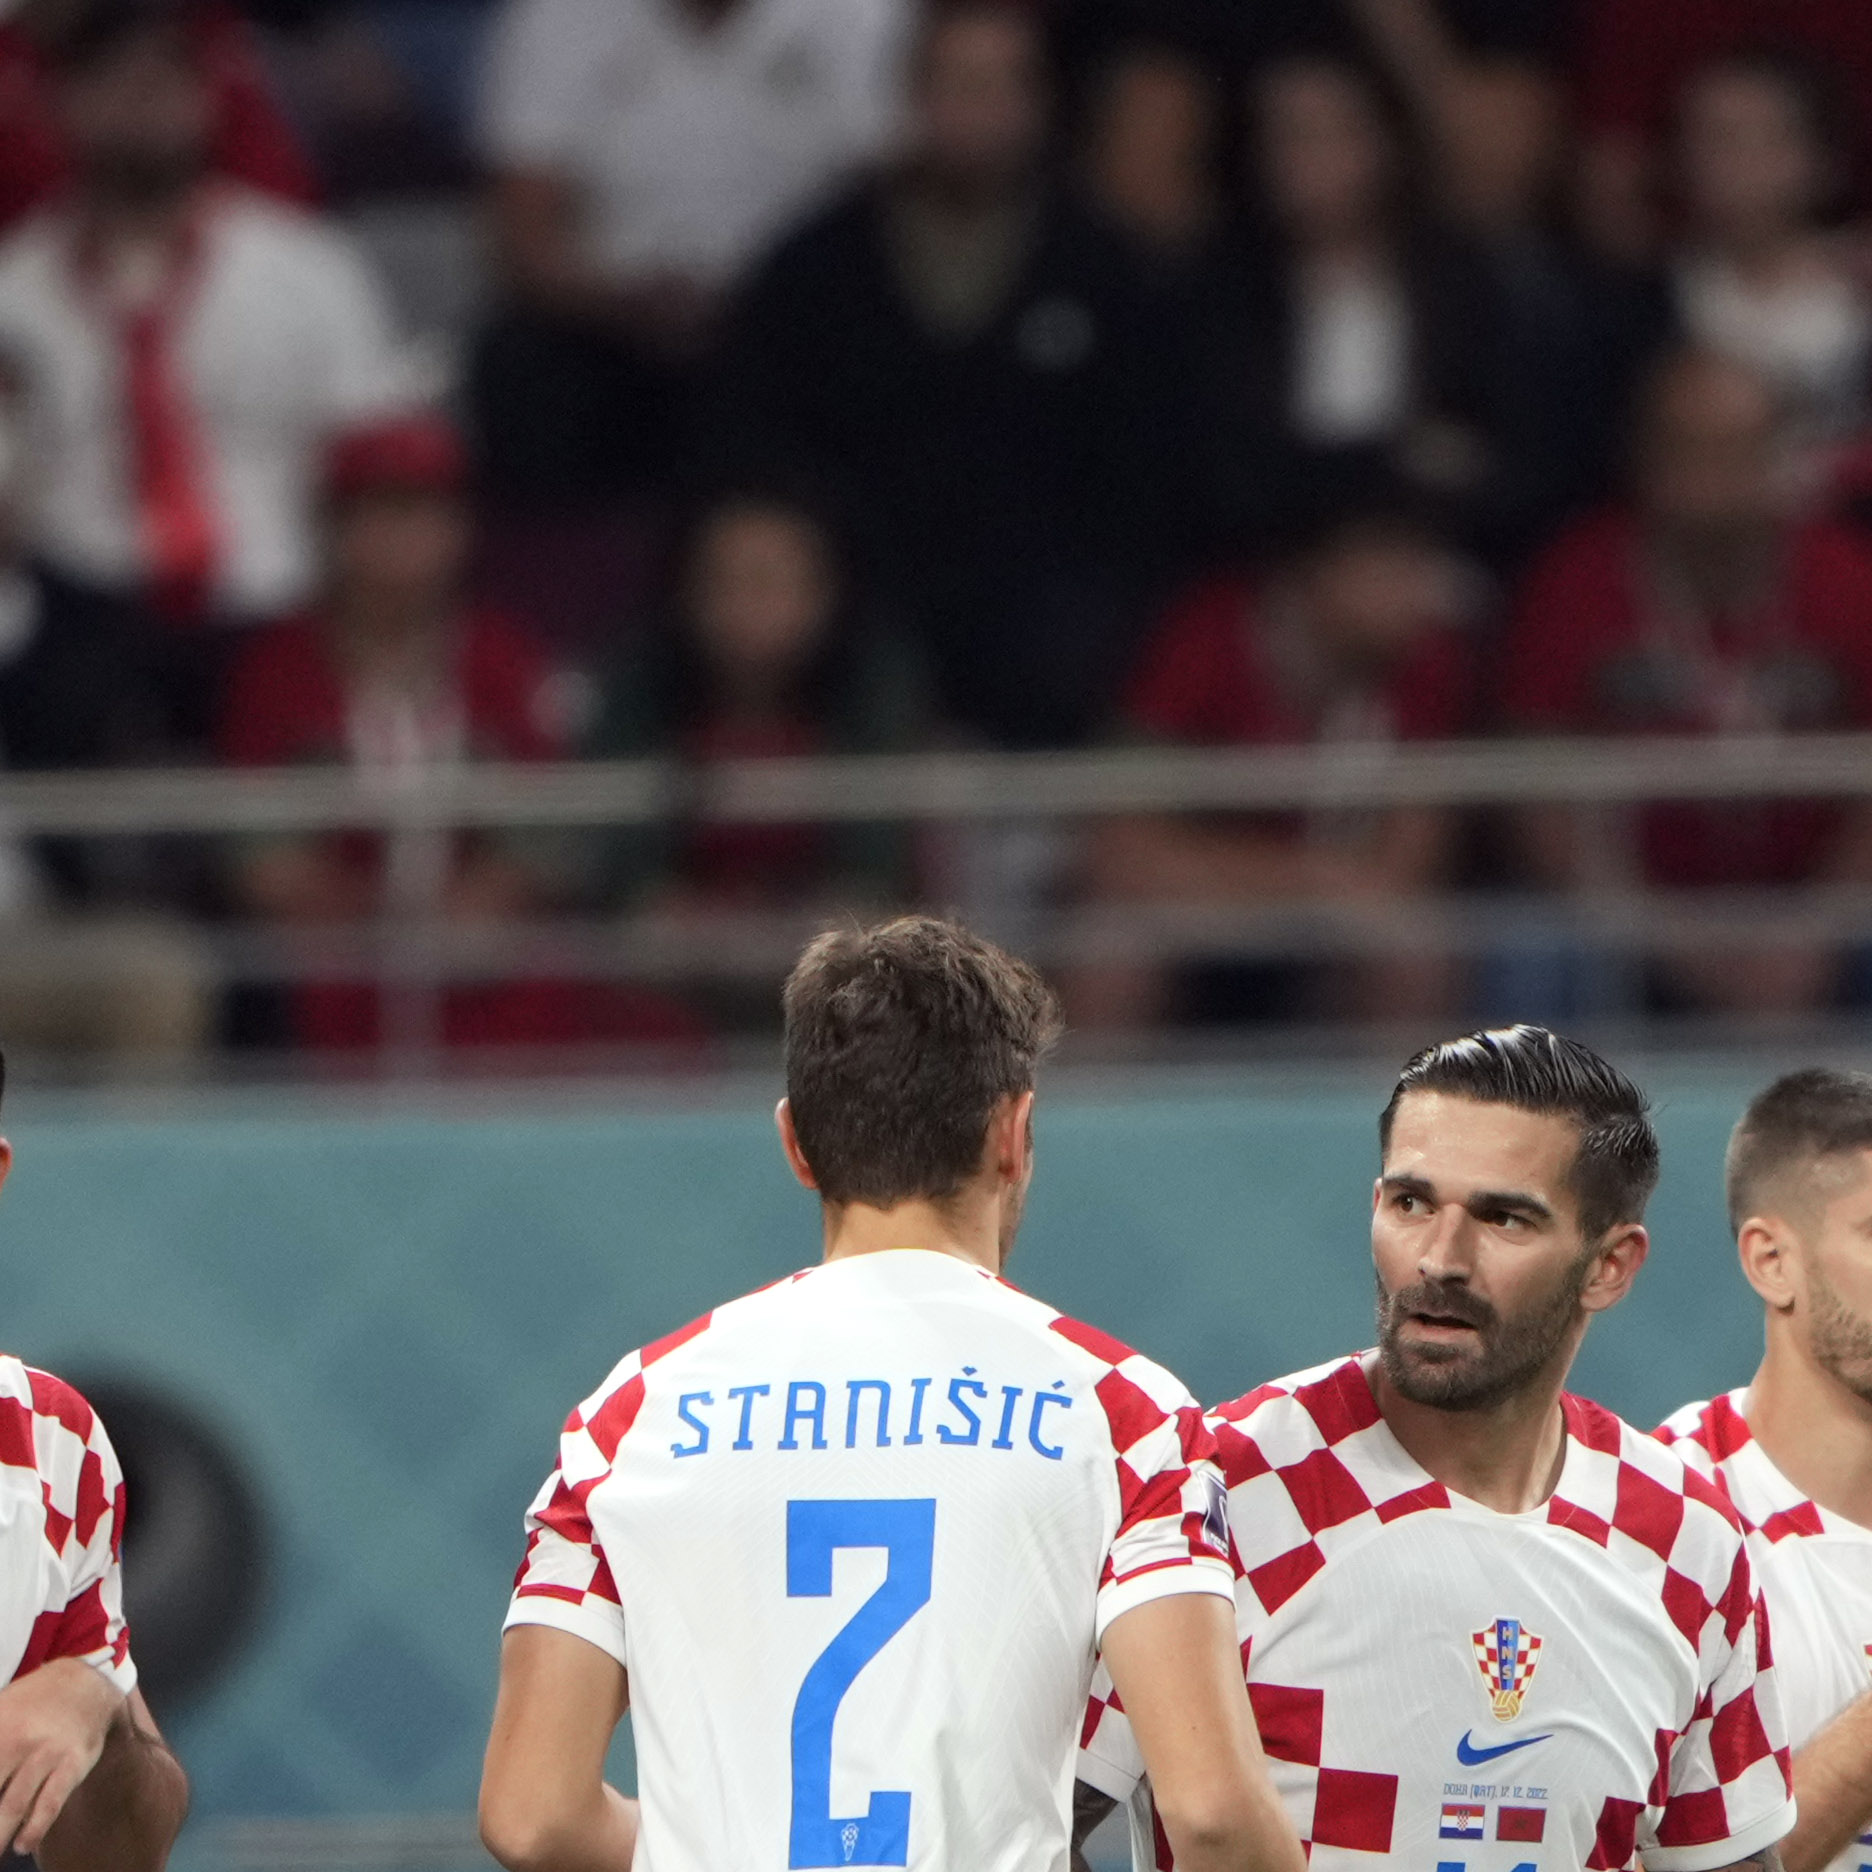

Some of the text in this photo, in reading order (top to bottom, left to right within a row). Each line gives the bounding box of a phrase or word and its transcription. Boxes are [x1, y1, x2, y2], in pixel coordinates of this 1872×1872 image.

[670, 1366, 1073, 1461] STANIŠIĆ
[786, 1498, 937, 1870] 2
[1501, 1626, 1515, 1680] HNS
